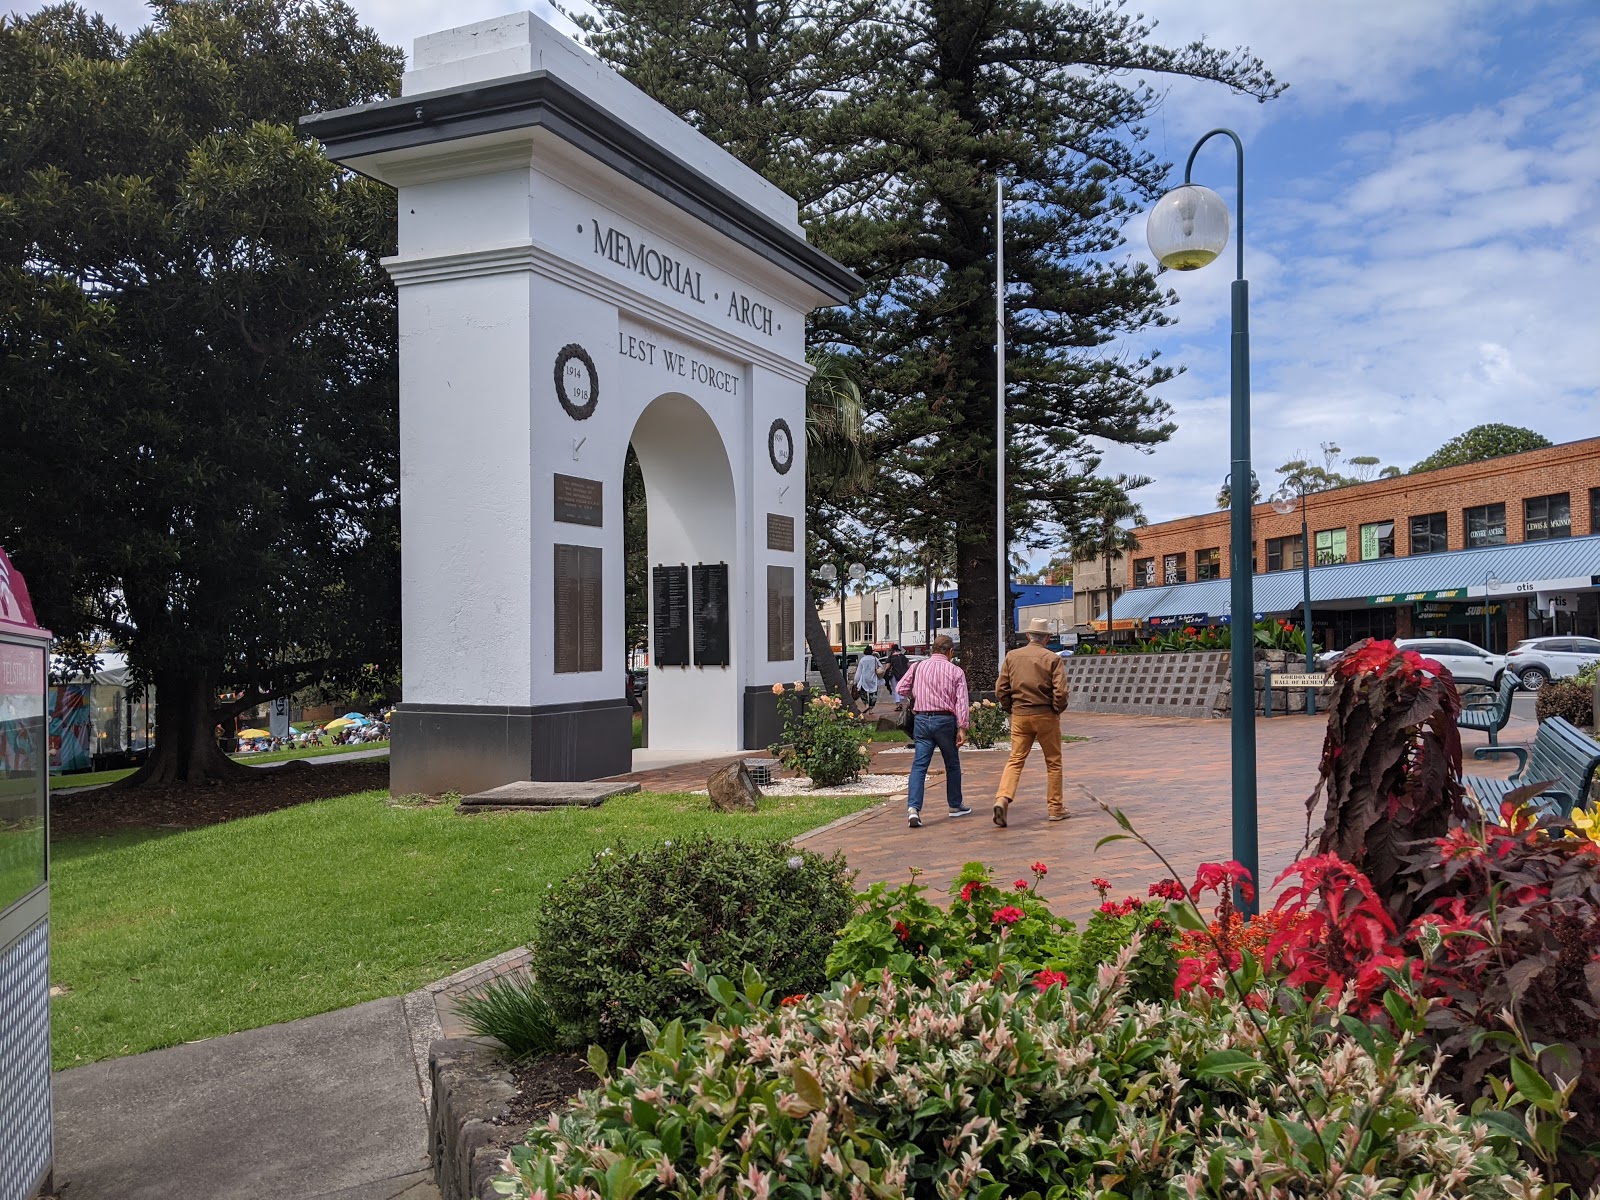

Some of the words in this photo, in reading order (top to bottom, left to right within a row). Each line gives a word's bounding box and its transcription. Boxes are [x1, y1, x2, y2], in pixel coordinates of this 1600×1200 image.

[592, 218, 706, 304] MEMORIAL
[727, 291, 773, 336] ARCH
[619, 332, 656, 365] LEST
[663, 349, 686, 377] WE
[691, 360, 739, 395] FORGET
[566, 365, 581, 379] 1914
[573, 387, 589, 400] 1918
[1517, 582, 1534, 592] otis
[1375, 595, 1395, 603] SUBWAY
[1405, 593, 1426, 601] SUBWAY
[1435, 590, 1458, 598] SUBWAY
[3, 661, 26, 685] TELSTRA
